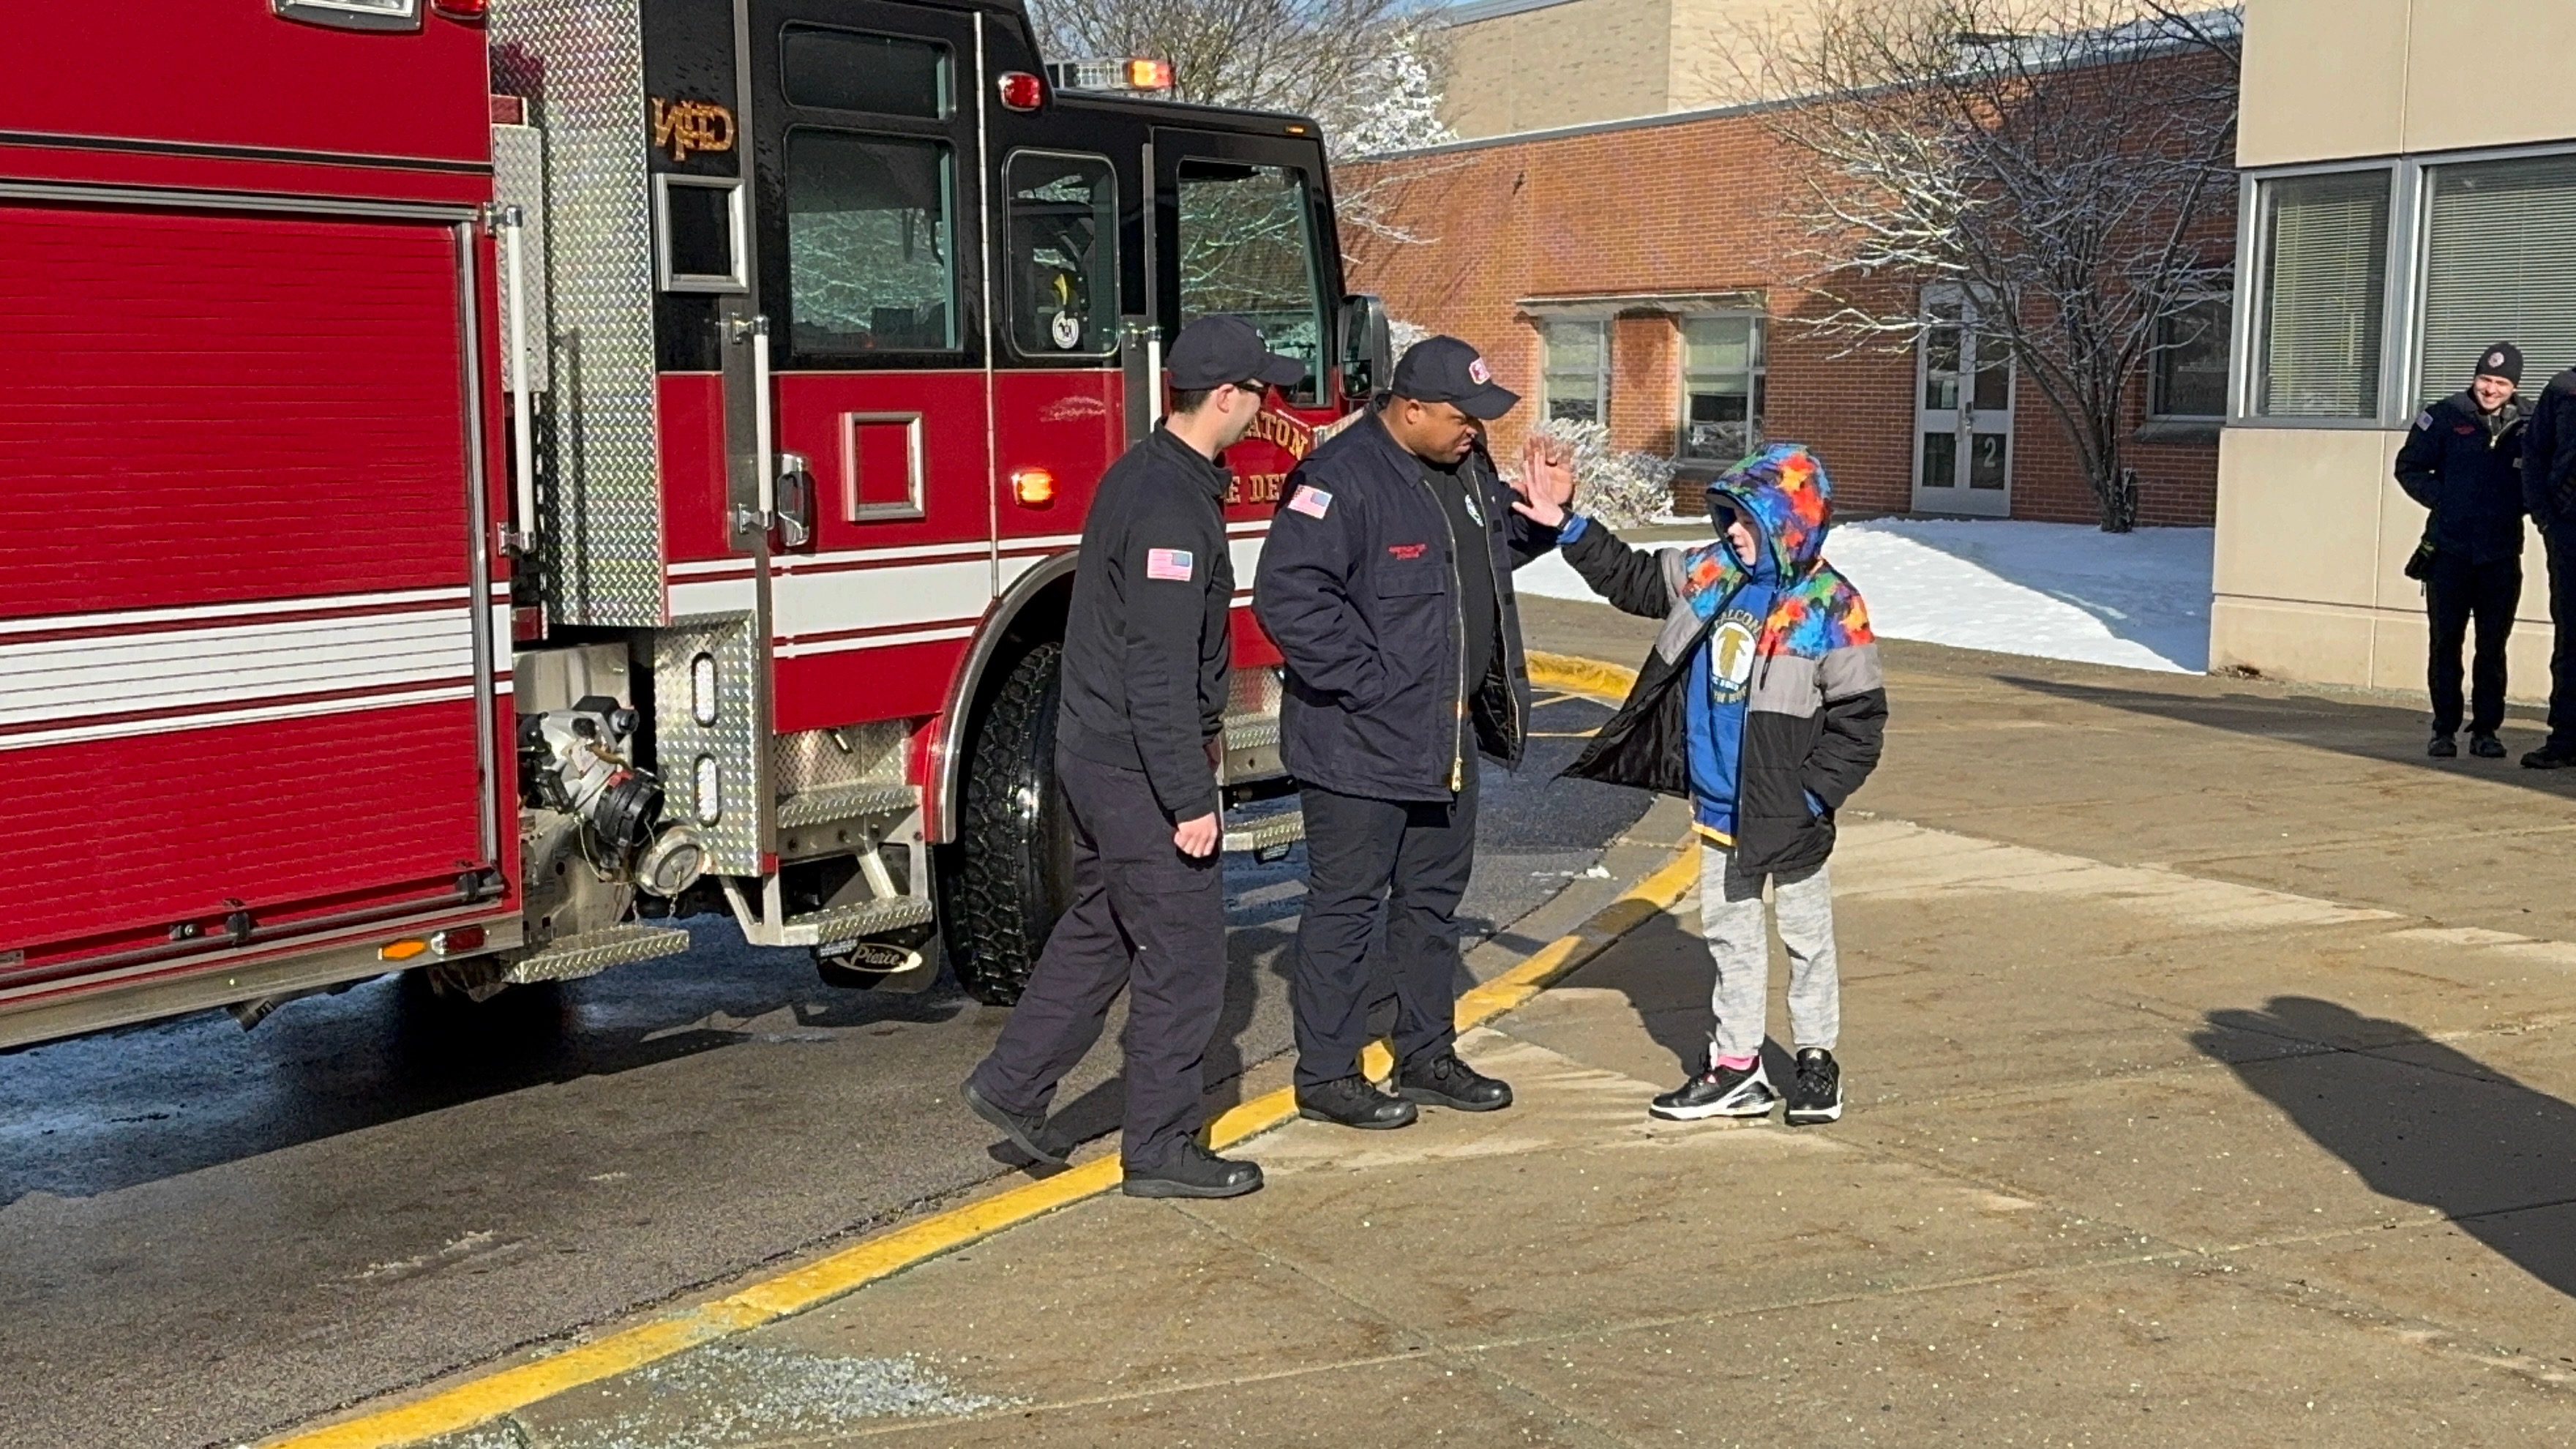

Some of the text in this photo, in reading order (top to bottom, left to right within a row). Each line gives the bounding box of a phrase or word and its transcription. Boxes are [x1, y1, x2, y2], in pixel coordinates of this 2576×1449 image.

[1244, 410, 1308, 461] ATON
[1984, 437, 1996, 468] 2
[850, 946, 900, 965] Pierce
